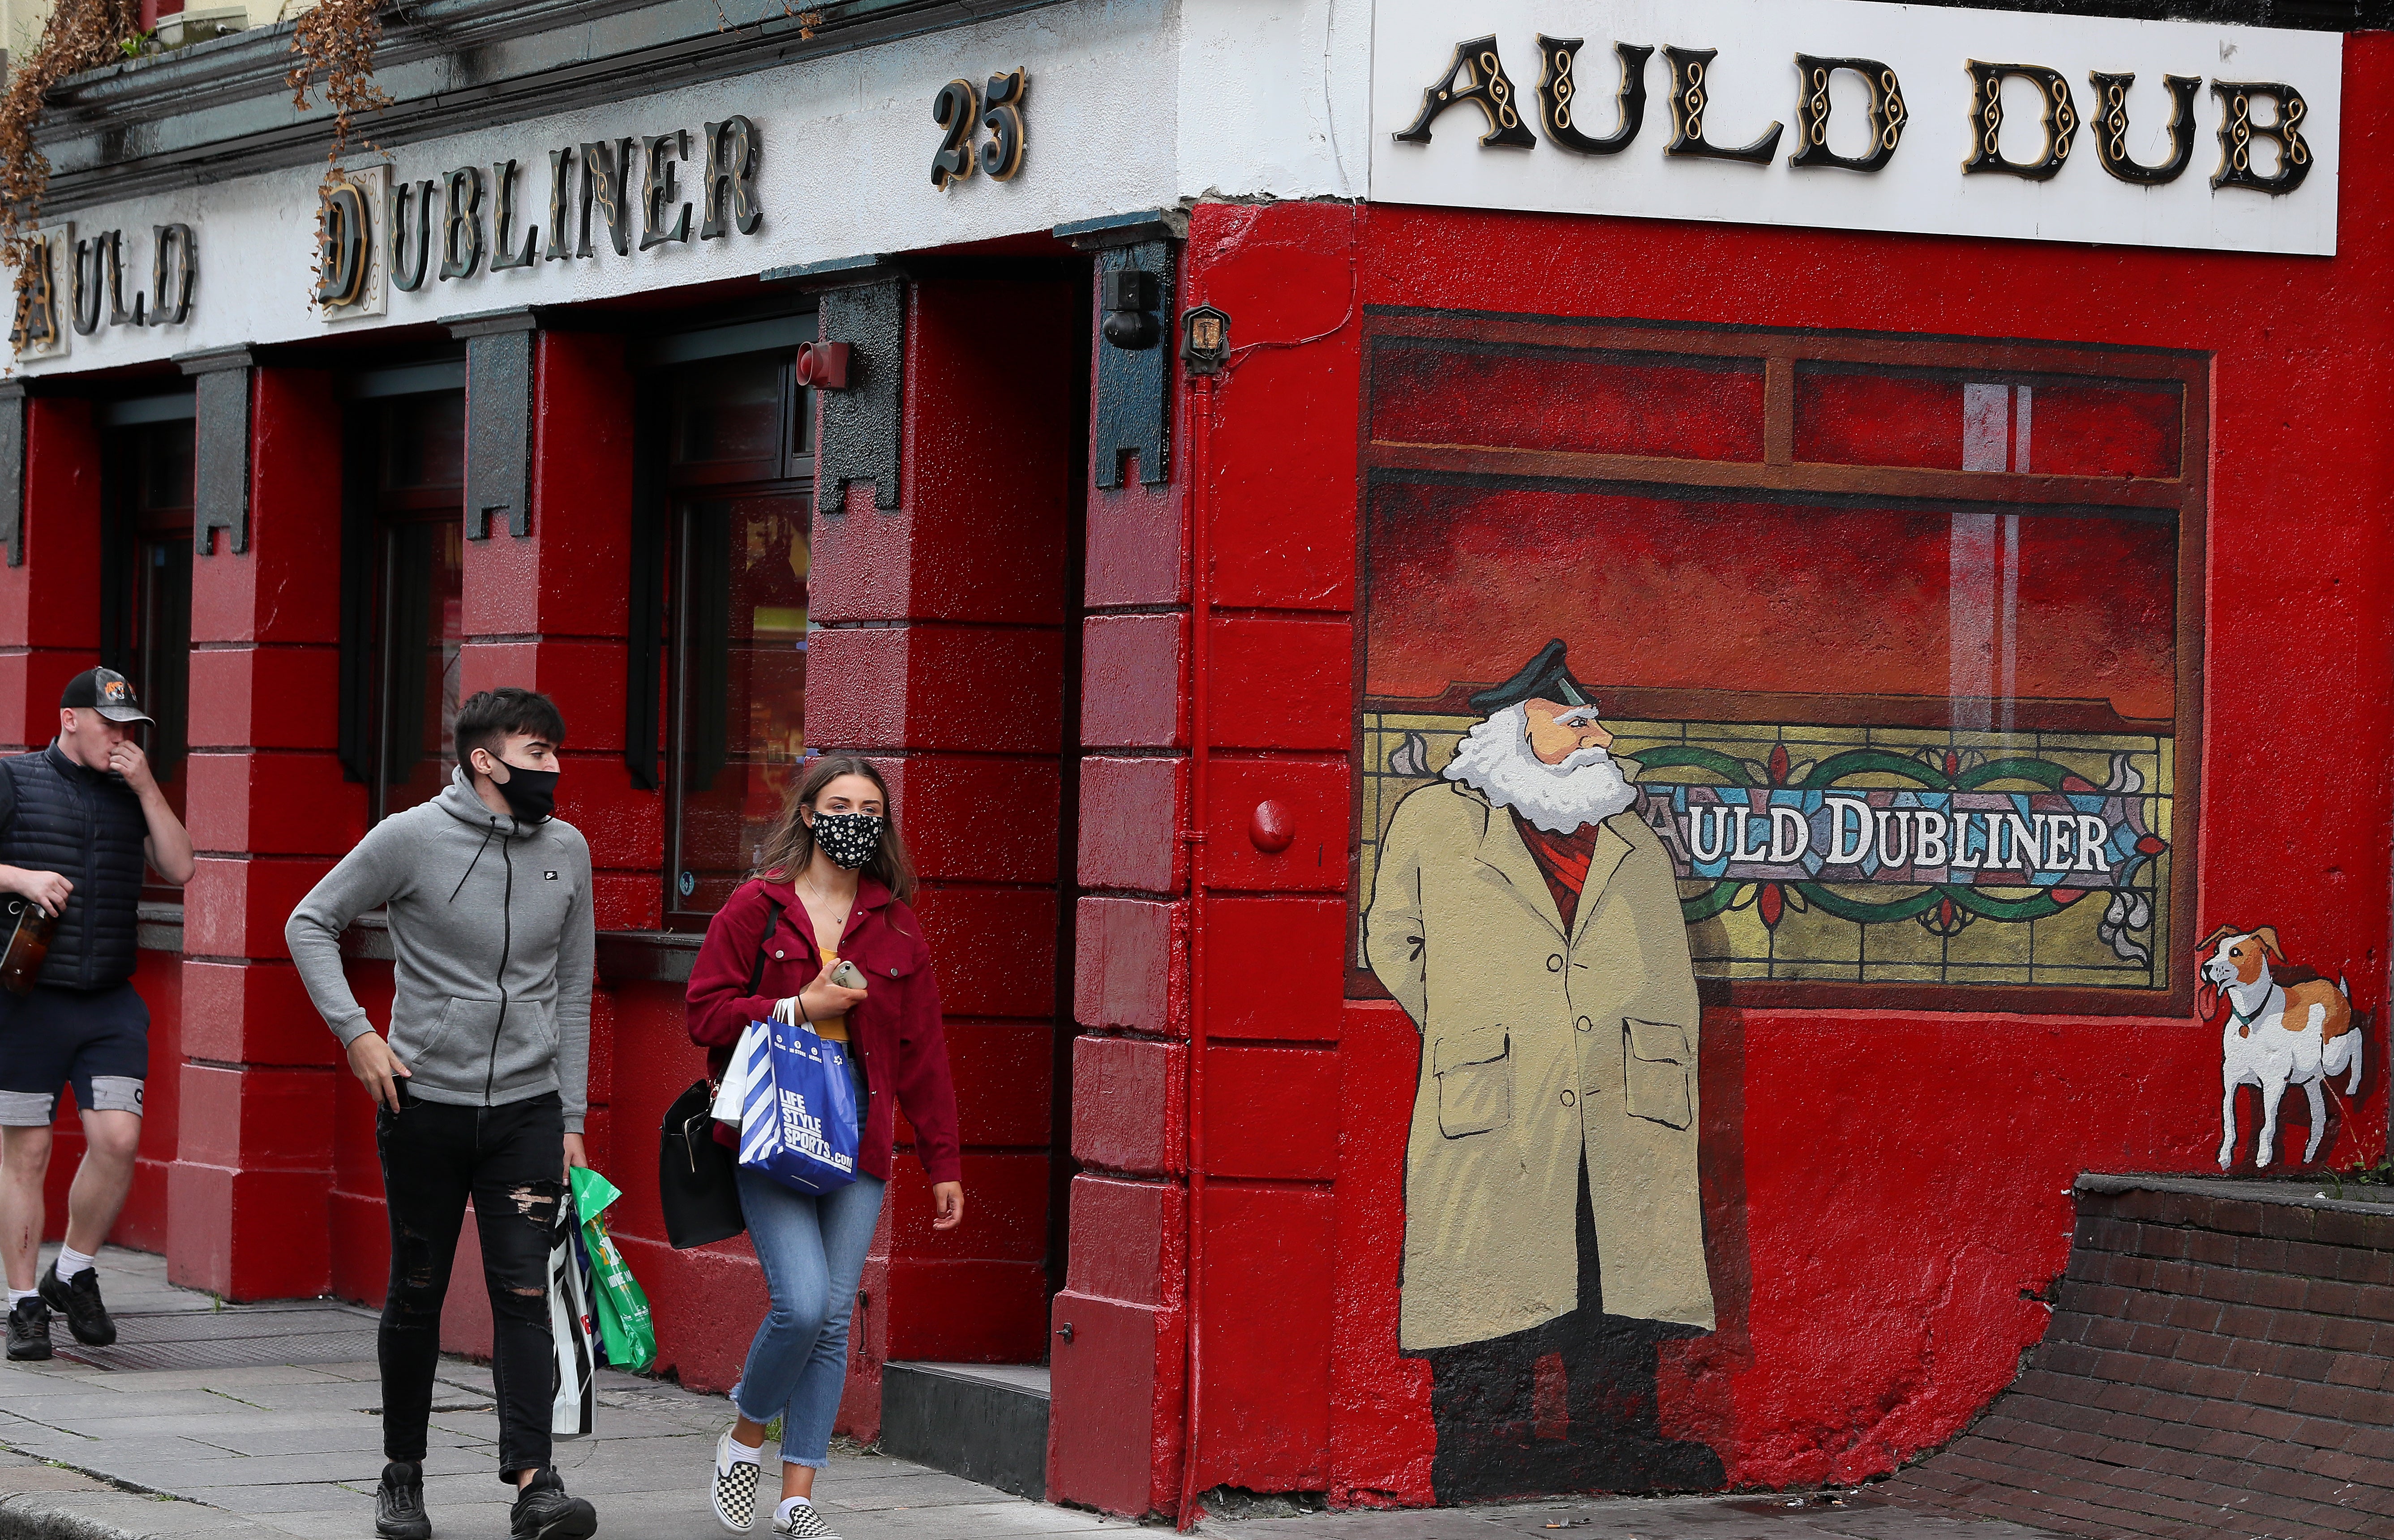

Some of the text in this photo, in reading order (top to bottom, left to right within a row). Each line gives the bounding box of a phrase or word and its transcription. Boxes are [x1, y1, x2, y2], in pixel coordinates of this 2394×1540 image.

[931, 66, 1025, 192] 25
[1392, 33, 2314, 194] AULD DUB
[318, 115, 763, 310] DUBLINER
[1824, 797, 2111, 872] DUBLINER
[794, 1049, 807, 1057] STORE
[779, 1088, 806, 1109] LIFE
[782, 1108, 822, 1134] STYLE
[607, 1272, 626, 1288] NINE
